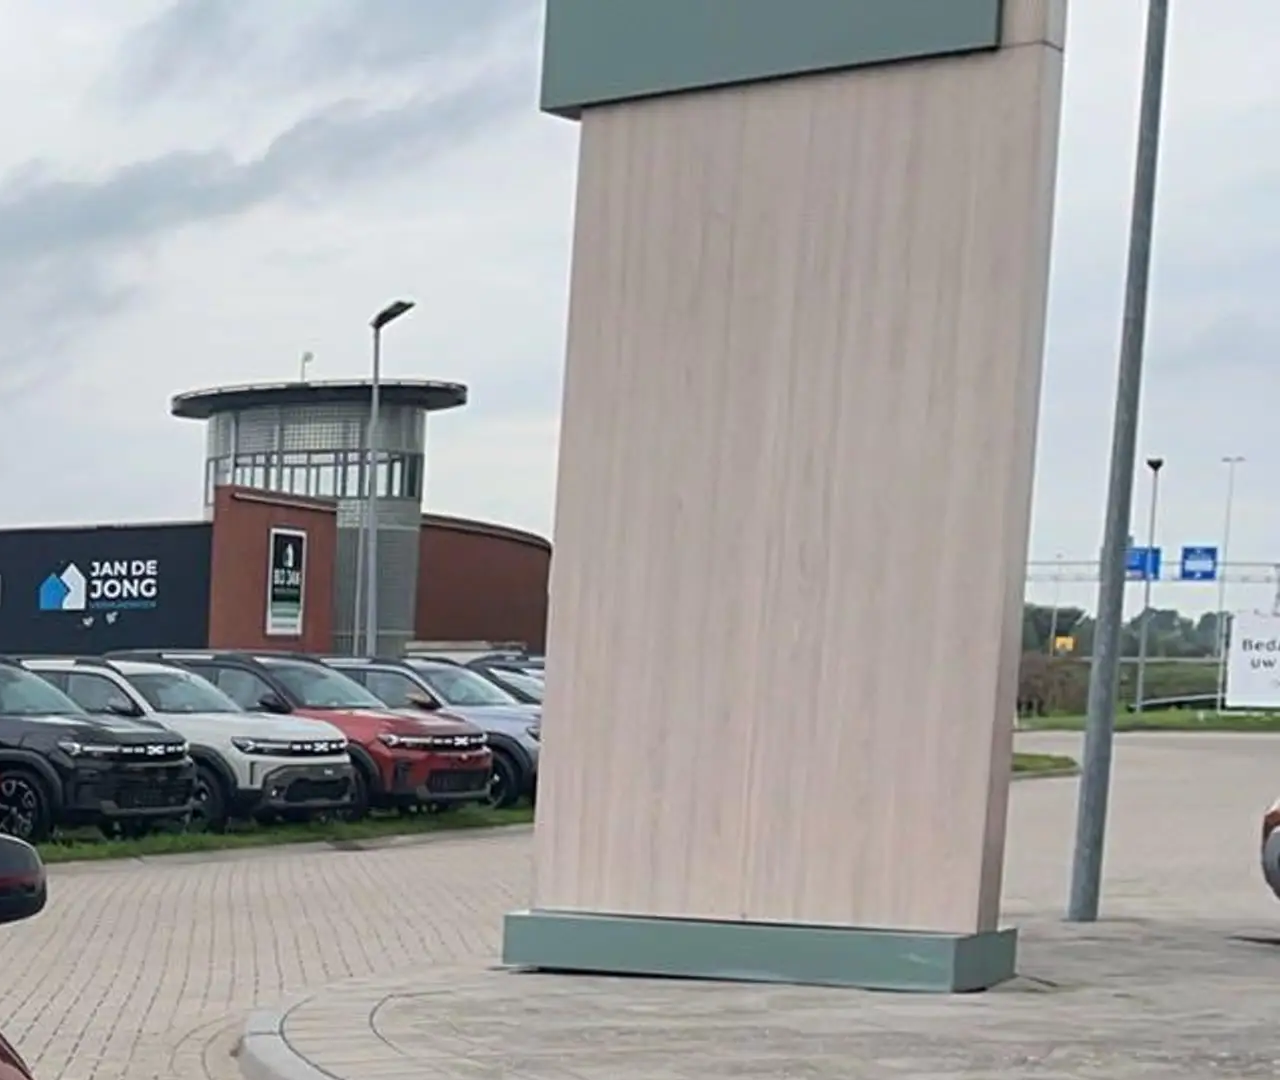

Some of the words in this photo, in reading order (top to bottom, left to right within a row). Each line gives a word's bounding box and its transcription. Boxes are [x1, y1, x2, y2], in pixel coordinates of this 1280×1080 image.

[90, 561, 127, 578] JAN
[131, 560, 158, 576] DE
[90, 579, 158, 599] JONG
